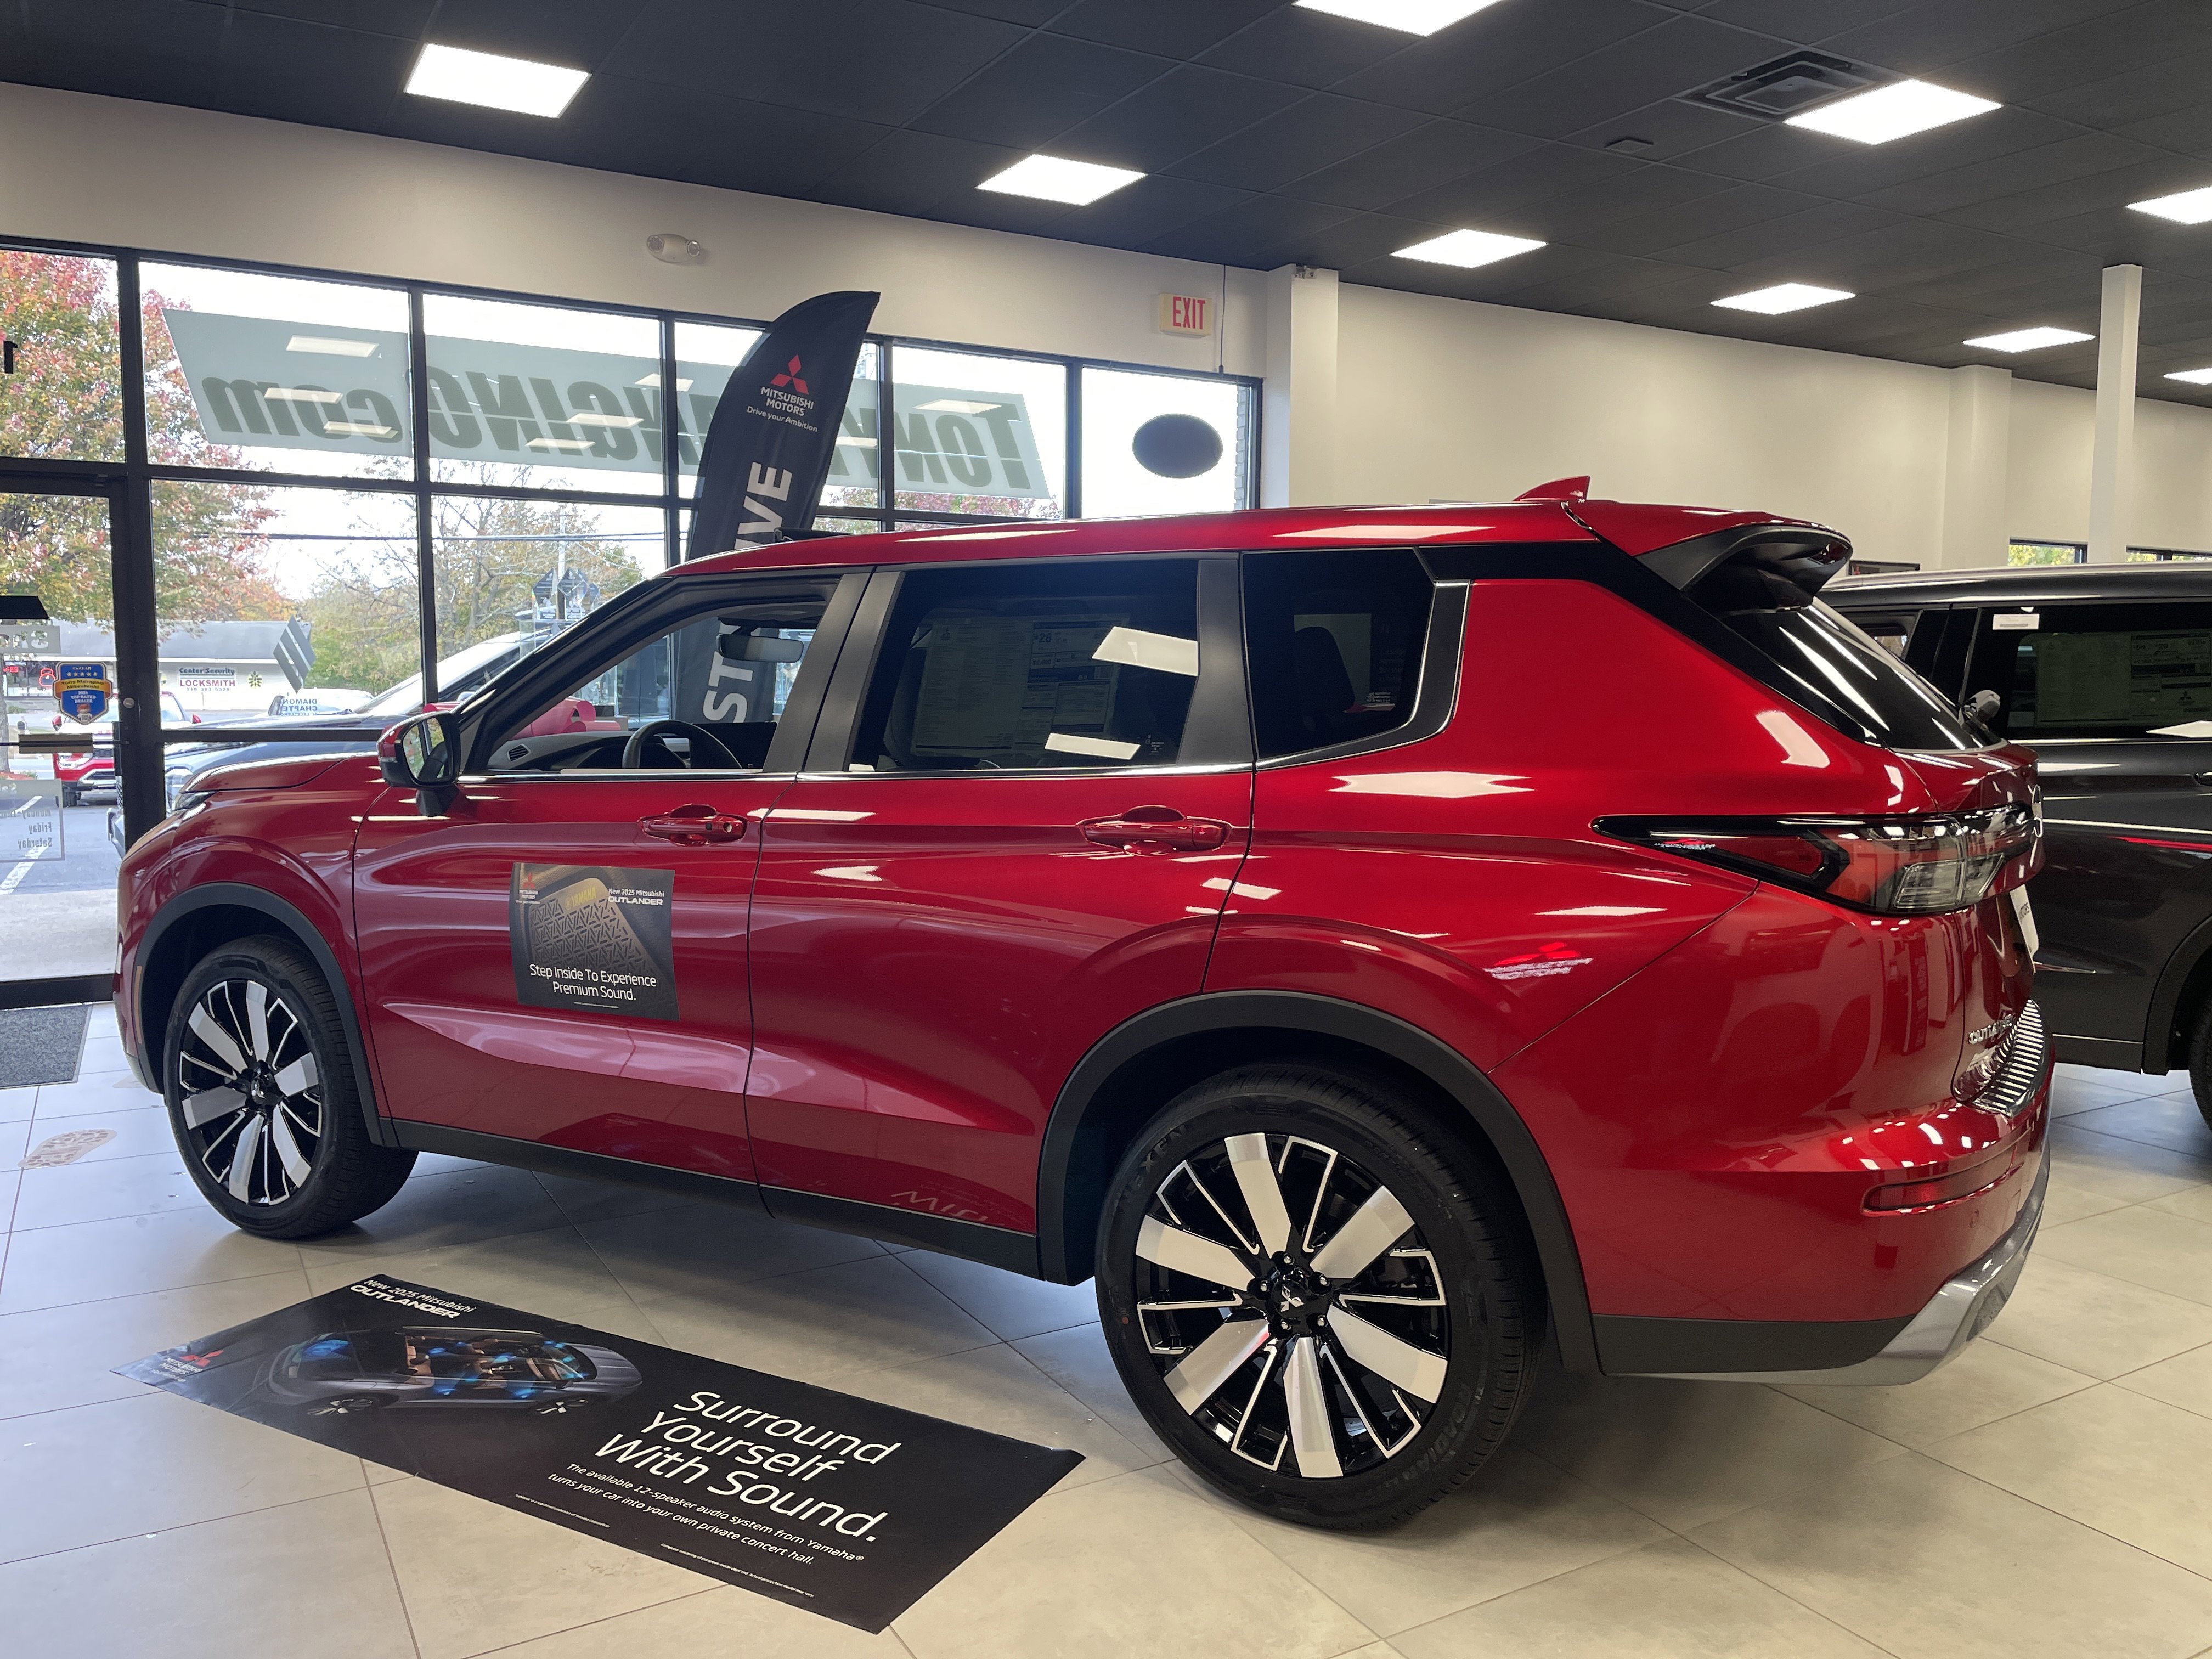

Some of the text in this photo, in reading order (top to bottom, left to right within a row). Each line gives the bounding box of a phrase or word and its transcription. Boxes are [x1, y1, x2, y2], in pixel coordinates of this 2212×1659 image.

[1173, 296, 1206, 330] EXIT
[760, 386, 814, 410] MITSUBISHI
[766, 398, 805, 416] MOTORS
[747, 406, 817, 432] Drive your Ambition
[571, 886, 597, 907] YAMAHA
[608, 896, 663, 906] OUTLANDER
[636, 889, 664, 898] Mitsubishi
[529, 964, 657, 987] Step Inside To Experience
[552, 981, 637, 1001] Premium Sound.
[350, 1285, 460, 1318] OUTLANDER
[363, 1279, 477, 1313] New 2025 Mitsubishi
[673, 1391, 902, 1464] Surround
[640, 1410, 845, 1481] Yourself
[594, 1433, 888, 1542] With Sound.
[567, 1463, 587, 1474] The
[586, 1470, 634, 1489] available
[633, 1485, 697, 1510] 12-speaker
[696, 1504, 729, 1519] audio
[729, 1516, 773, 1535] system
[774, 1530, 805, 1544] from
[548, 1473, 816, 1565] turns your car into your own private concert hall.
